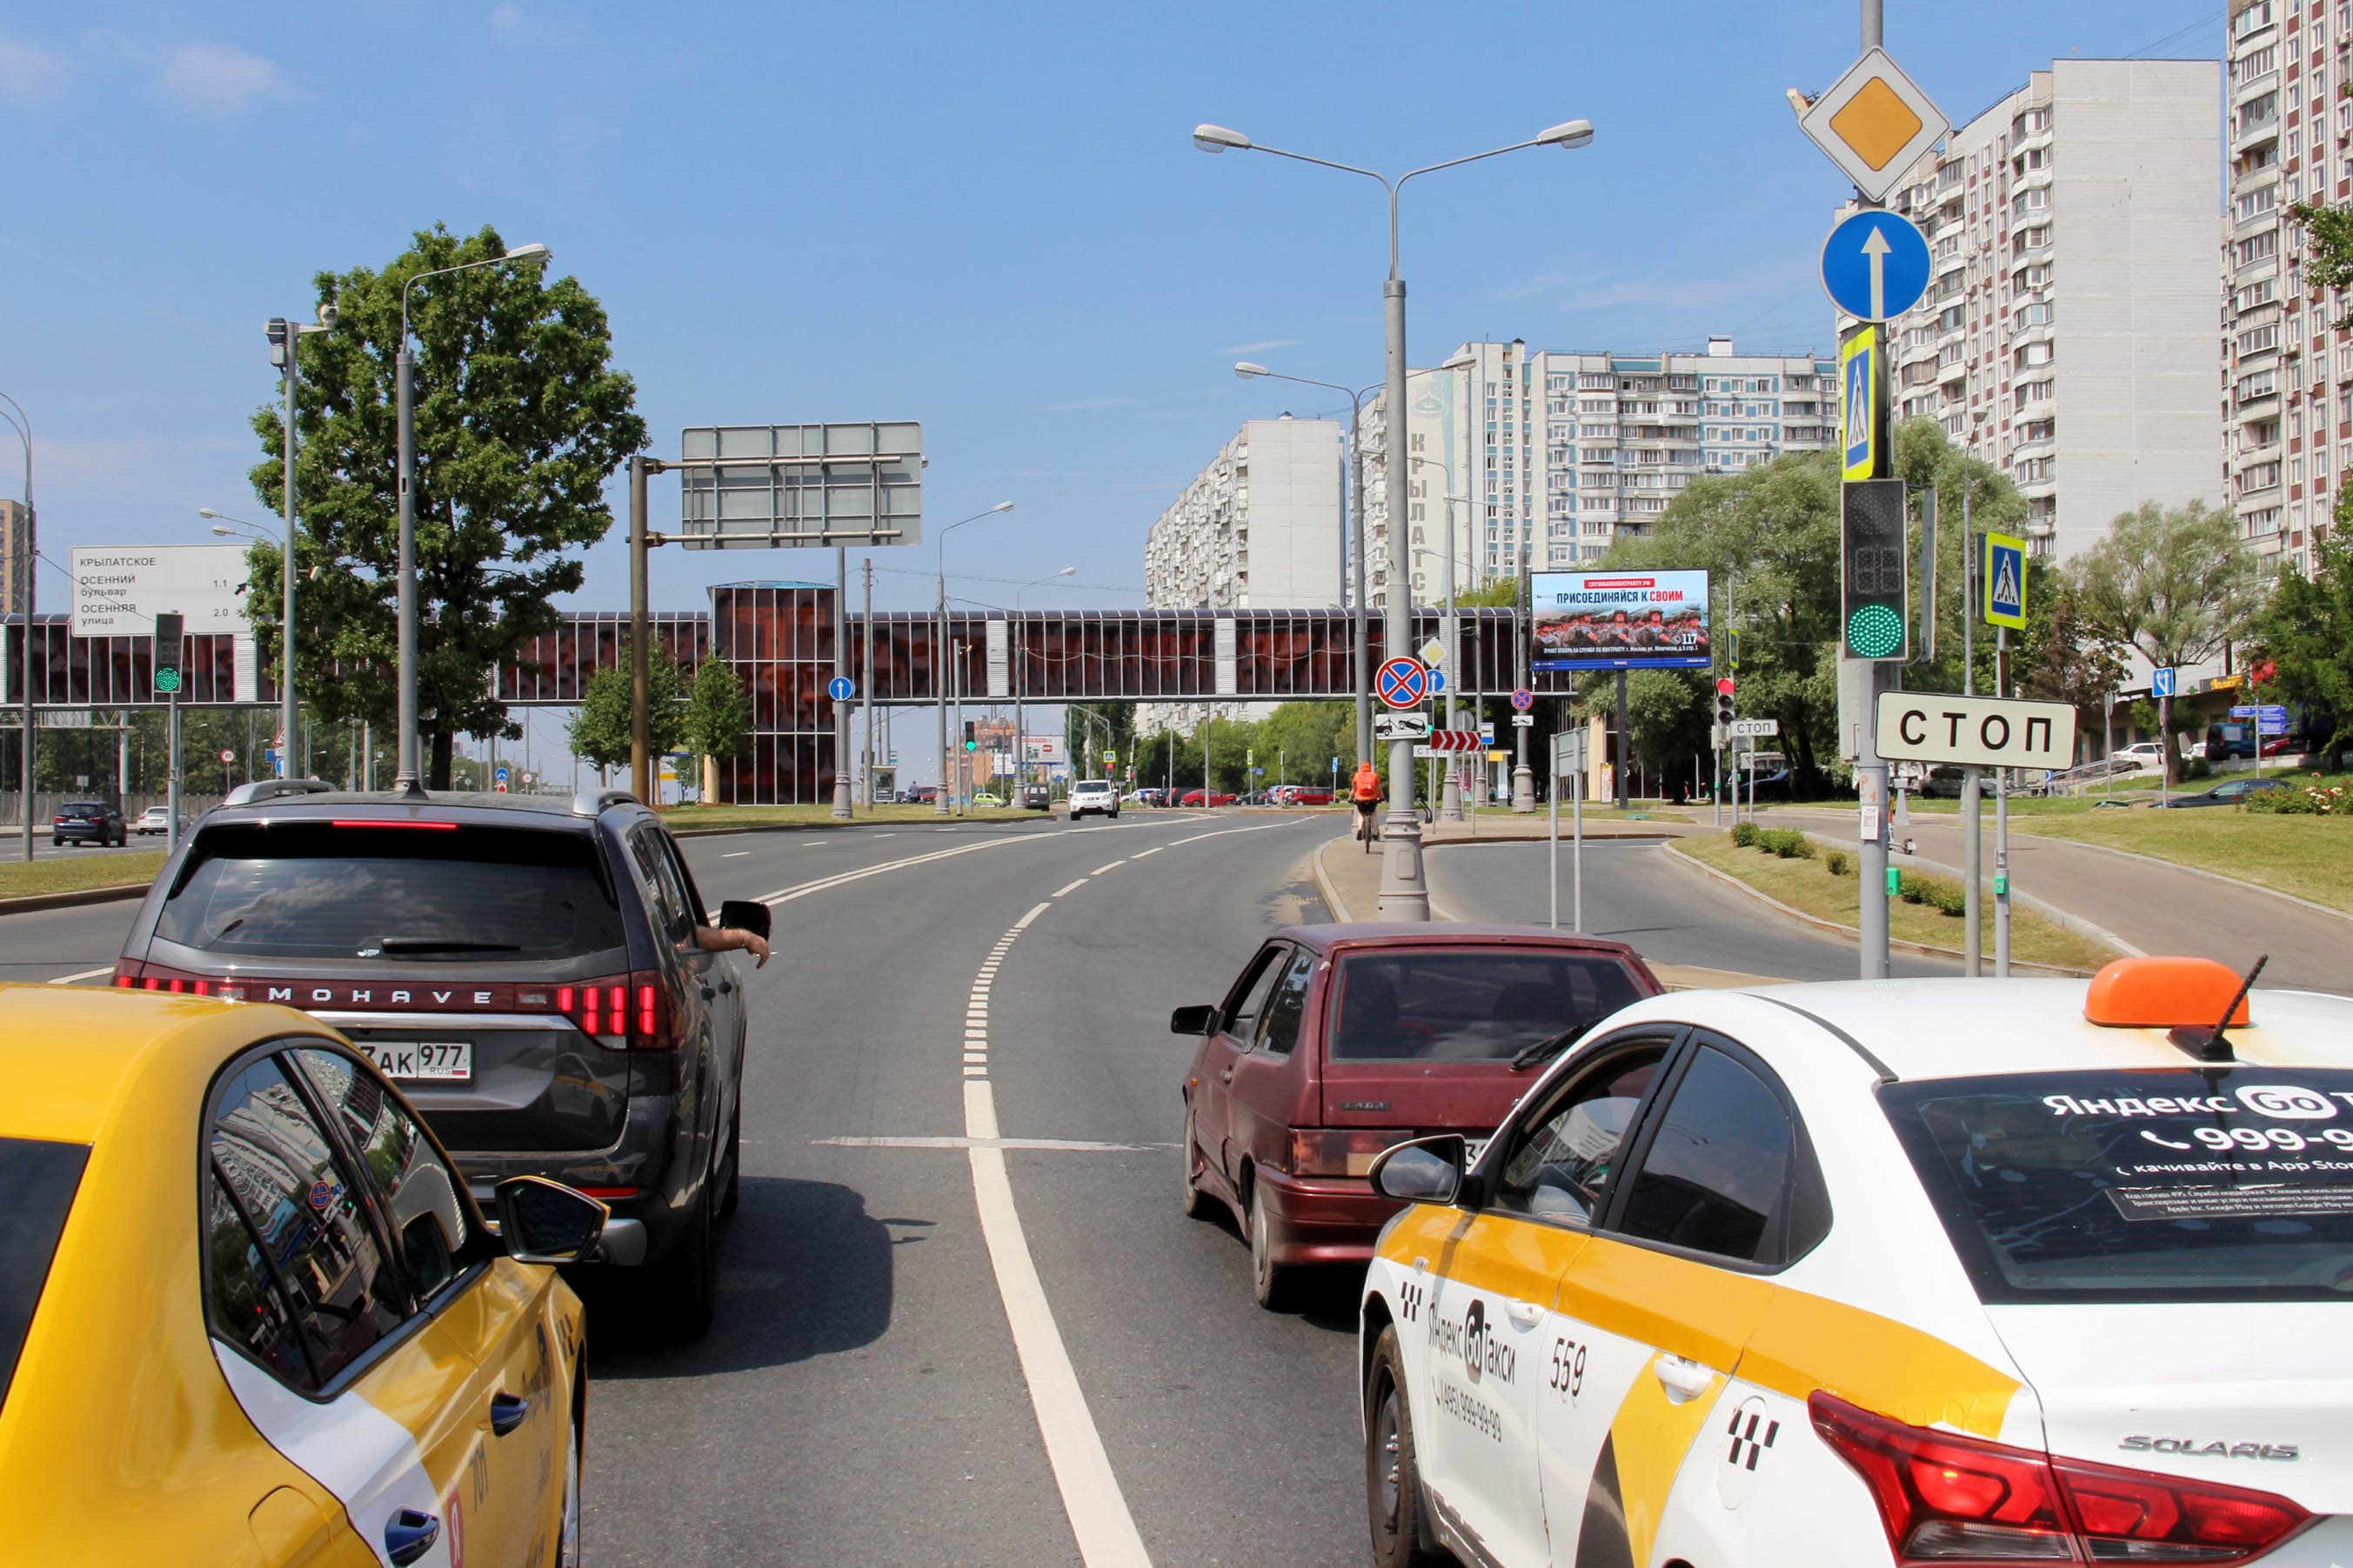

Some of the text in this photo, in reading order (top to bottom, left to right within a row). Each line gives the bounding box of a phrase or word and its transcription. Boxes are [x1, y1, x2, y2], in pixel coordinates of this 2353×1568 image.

[80, 557, 157, 567] КРЫЛАТСКОЕ
[81, 574, 136, 585] ОСЕННИЙ
[81, 588, 127, 597] бульвар
[1556, 589, 1683, 604] ПРИСОЕДИНЯЙСЯ К СВОИМ
[81, 604, 137, 613] ОСЕННЯЯ
[213, 608, 229, 617] 2.0
[1681, 633, 1697, 644] 117
[1736, 723, 1771, 734] СТОП
[1900, 710, 2052, 752] СТОП
[268, 987, 492, 1004] MOHAVE
[420, 1044, 463, 1066] 977
[430, 1066, 452, 1075] RUS
[2042, 1094, 2238, 1117] Яндекс
[2249, 1091, 2324, 1111] Go
[2267, 1160, 2311, 1171] App
[1427, 1302, 1463, 1360] Яндекс
[1484, 1321, 1516, 1385] Такси
[1550, 1337, 1588, 1398] 559
[1440, 1378, 1502, 1444] (495) 999-99-99
[2117, 1435, 2301, 1462] SOLARIS
